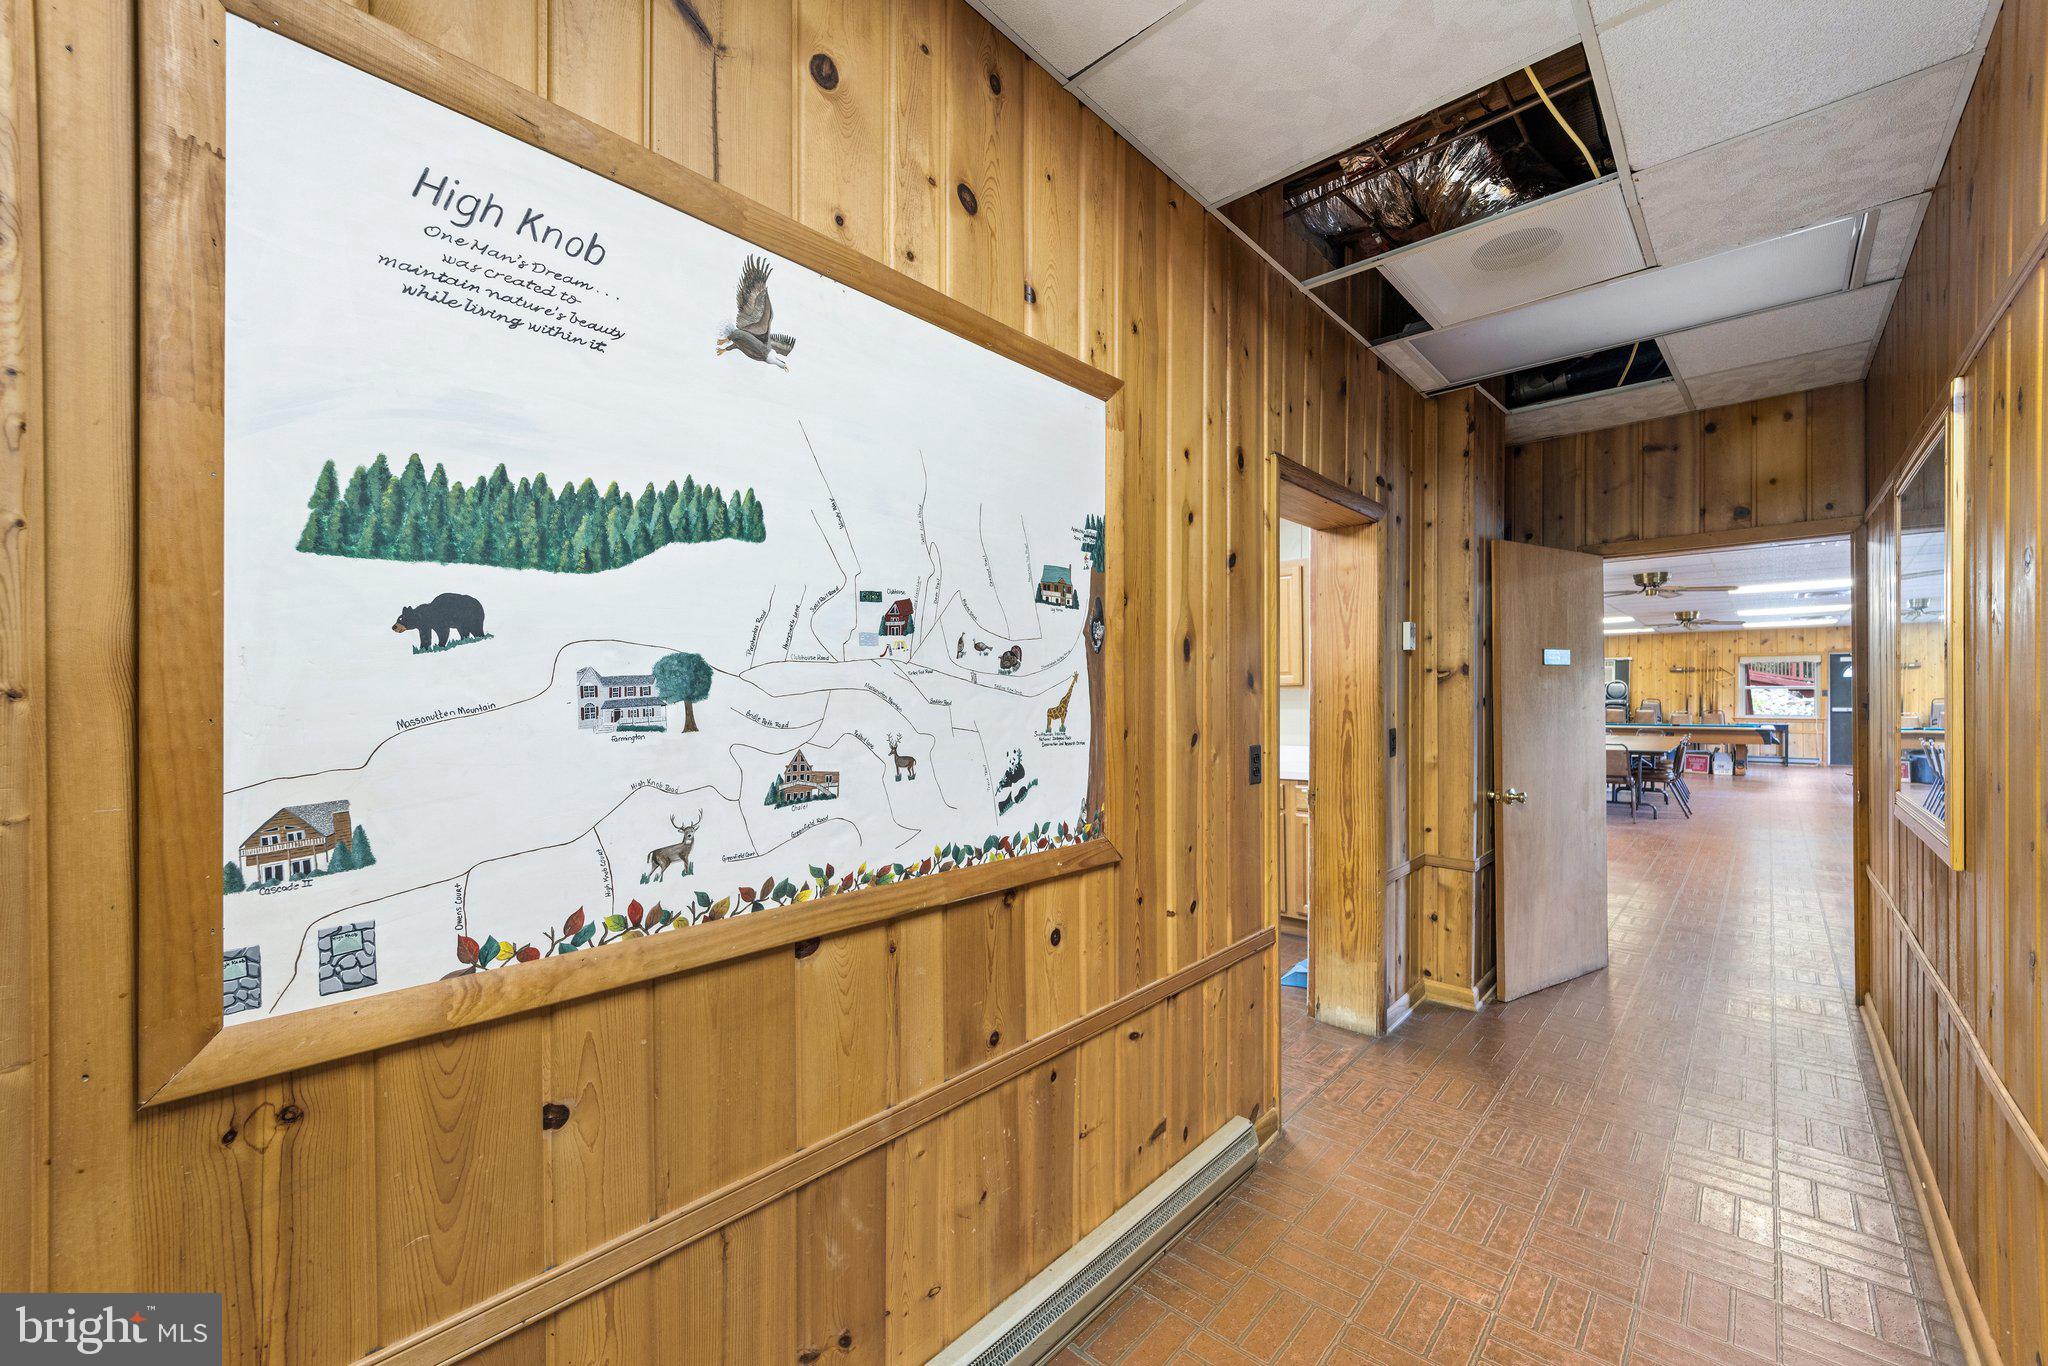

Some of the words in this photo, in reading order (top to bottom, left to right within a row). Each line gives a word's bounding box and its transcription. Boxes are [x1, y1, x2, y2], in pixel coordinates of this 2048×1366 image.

[412, 167, 503, 228] High
[516, 208, 605, 265] Knob
[424, 226, 469, 246] One
[470, 239, 528, 269] Man's
[441, 254, 482, 272] was
[484, 269, 557, 297] created
[560, 291, 582, 304] to
[378, 254, 480, 293] maintain
[485, 289, 566, 320] nature's
[569, 311, 626, 341] beauty
[402, 283, 462, 308] while
[463, 298, 524, 329] living
[528, 322, 587, 345] within
[755, 610, 767, 623] Road
[396, 709, 456, 730] Massanutten
[457, 702, 496, 715] Mountain
[745, 709, 761, 722] Bridle
[774, 720, 790, 729] Road
[611, 733, 646, 743] Farmington
[630, 780, 645, 790] High
[646, 778, 662, 788] Knob
[665, 784, 680, 794] Road
[816, 815, 829, 824] Road
[596, 848, 606, 867] Court
[602, 867, 610, 883] Knob
[259, 882, 300, 895] Cascade
[454, 883, 464, 905] Court
[605, 883, 613, 897] High
[454, 905, 464, 931] Owens
